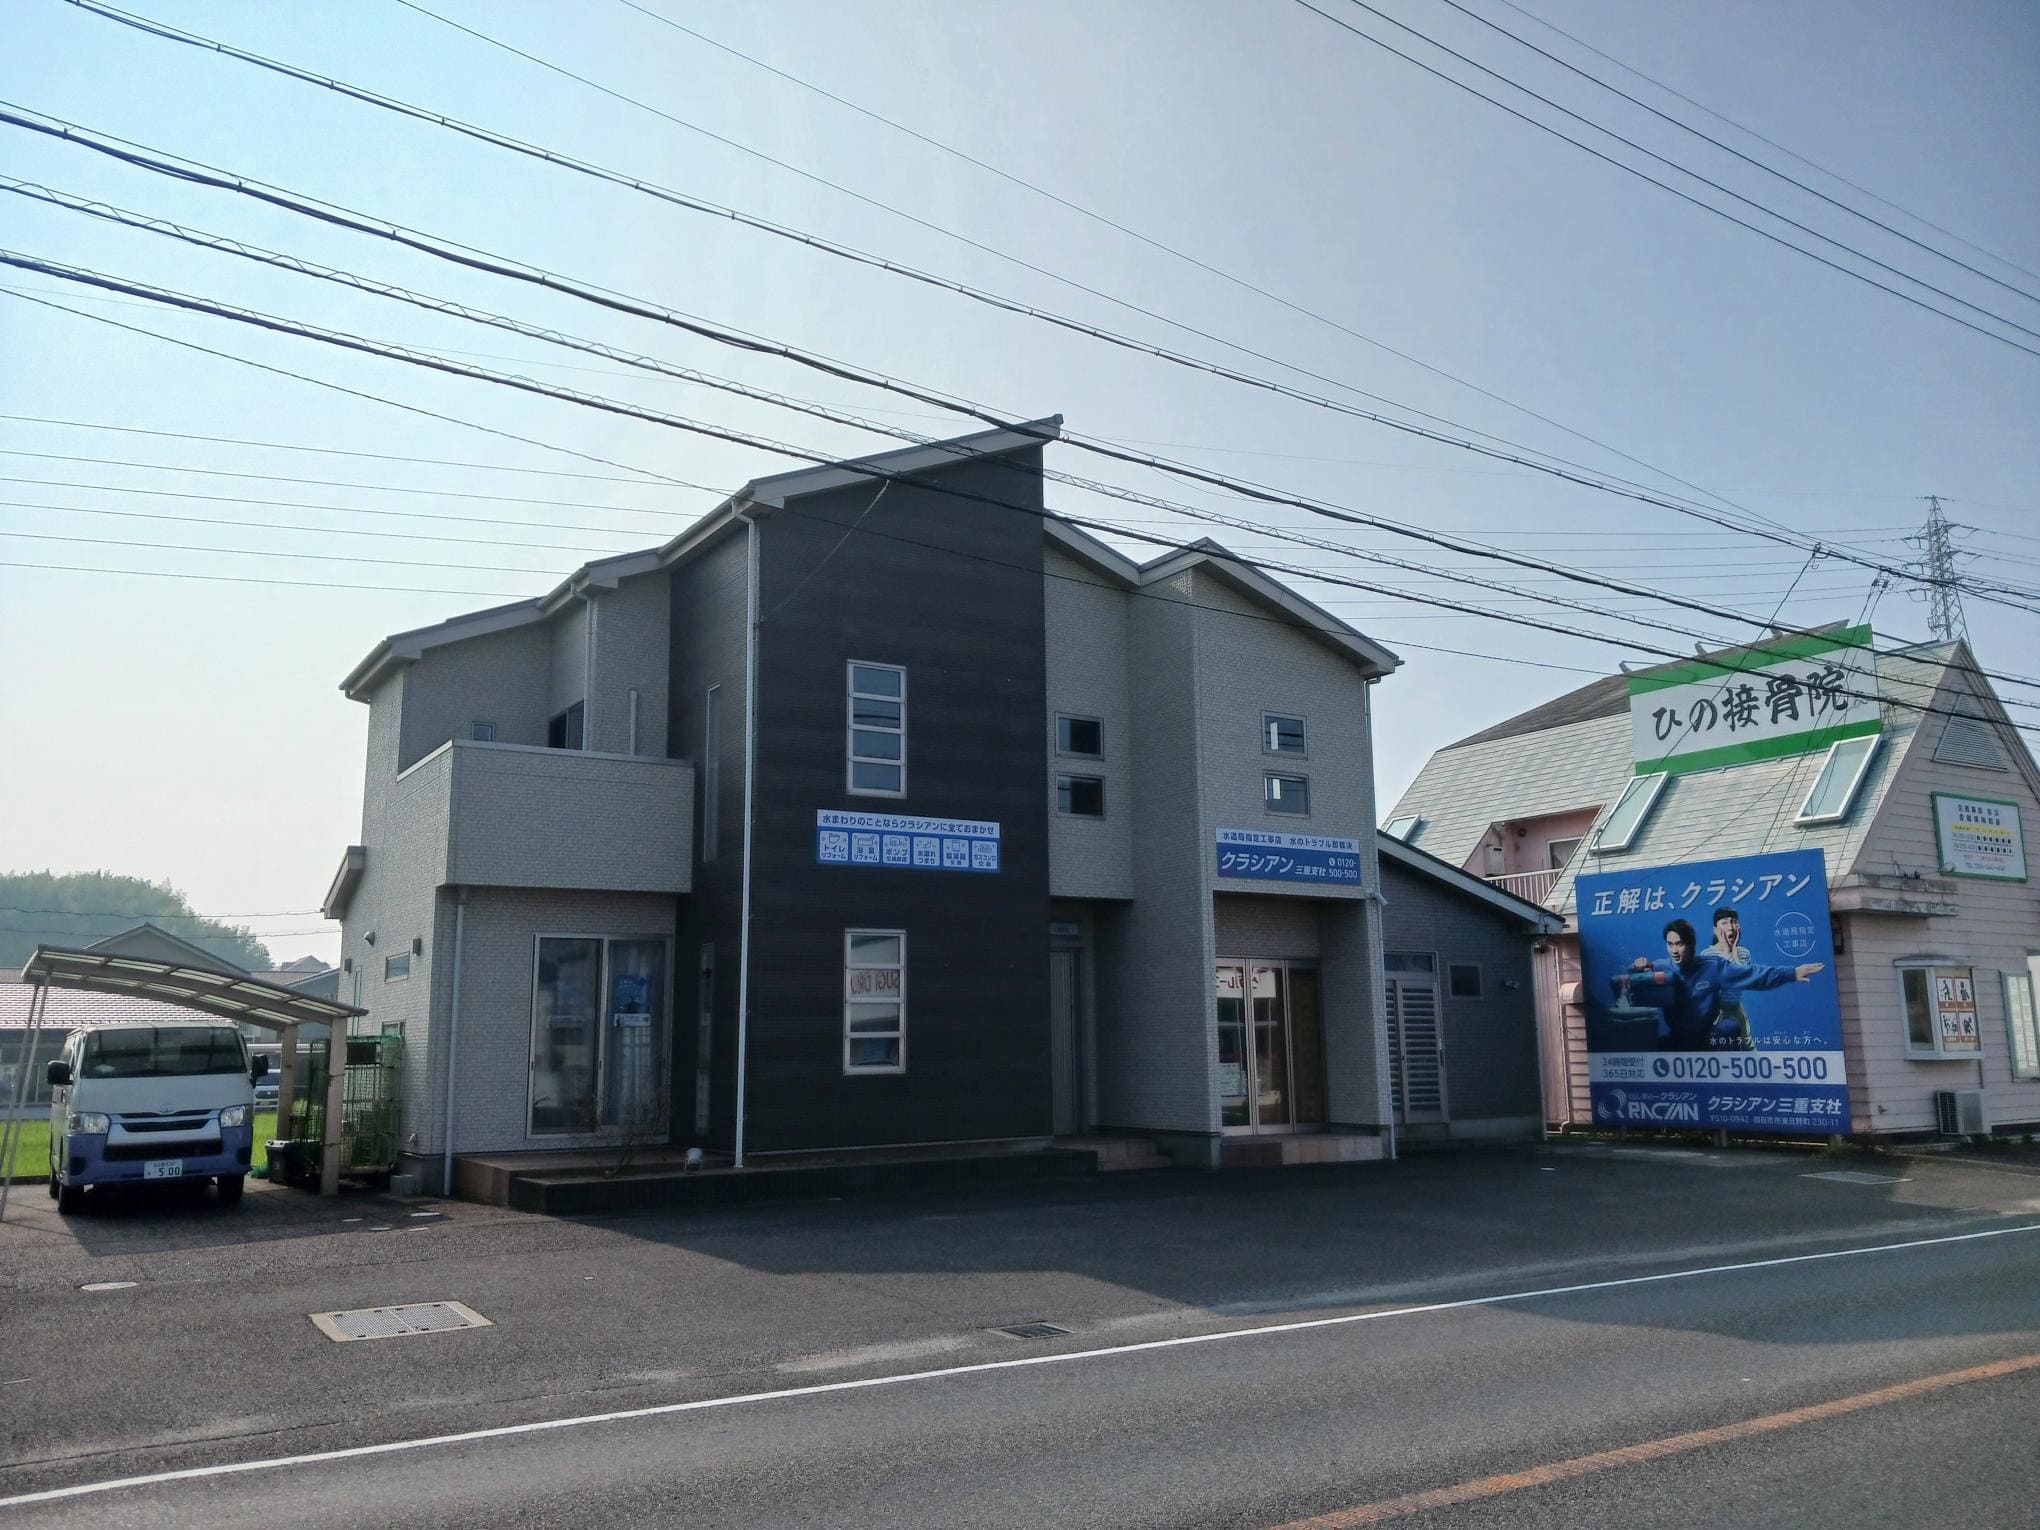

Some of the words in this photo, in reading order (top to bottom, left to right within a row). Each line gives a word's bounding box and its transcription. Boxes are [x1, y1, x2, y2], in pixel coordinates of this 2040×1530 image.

[1652, 665, 1849, 741] ひの接骨院
[822, 813, 995, 835] 水まわりのことならクラシアンに全ておまかせ
[824, 844, 845, 852] トイレ
[1221, 852, 1295, 873] クラシアン
[1328, 868, 1358, 879] 500-500
[1591, 873, 1812, 916] 正解は、クラシアン
[1673, 1056, 1828, 1080] 0120-500-500
